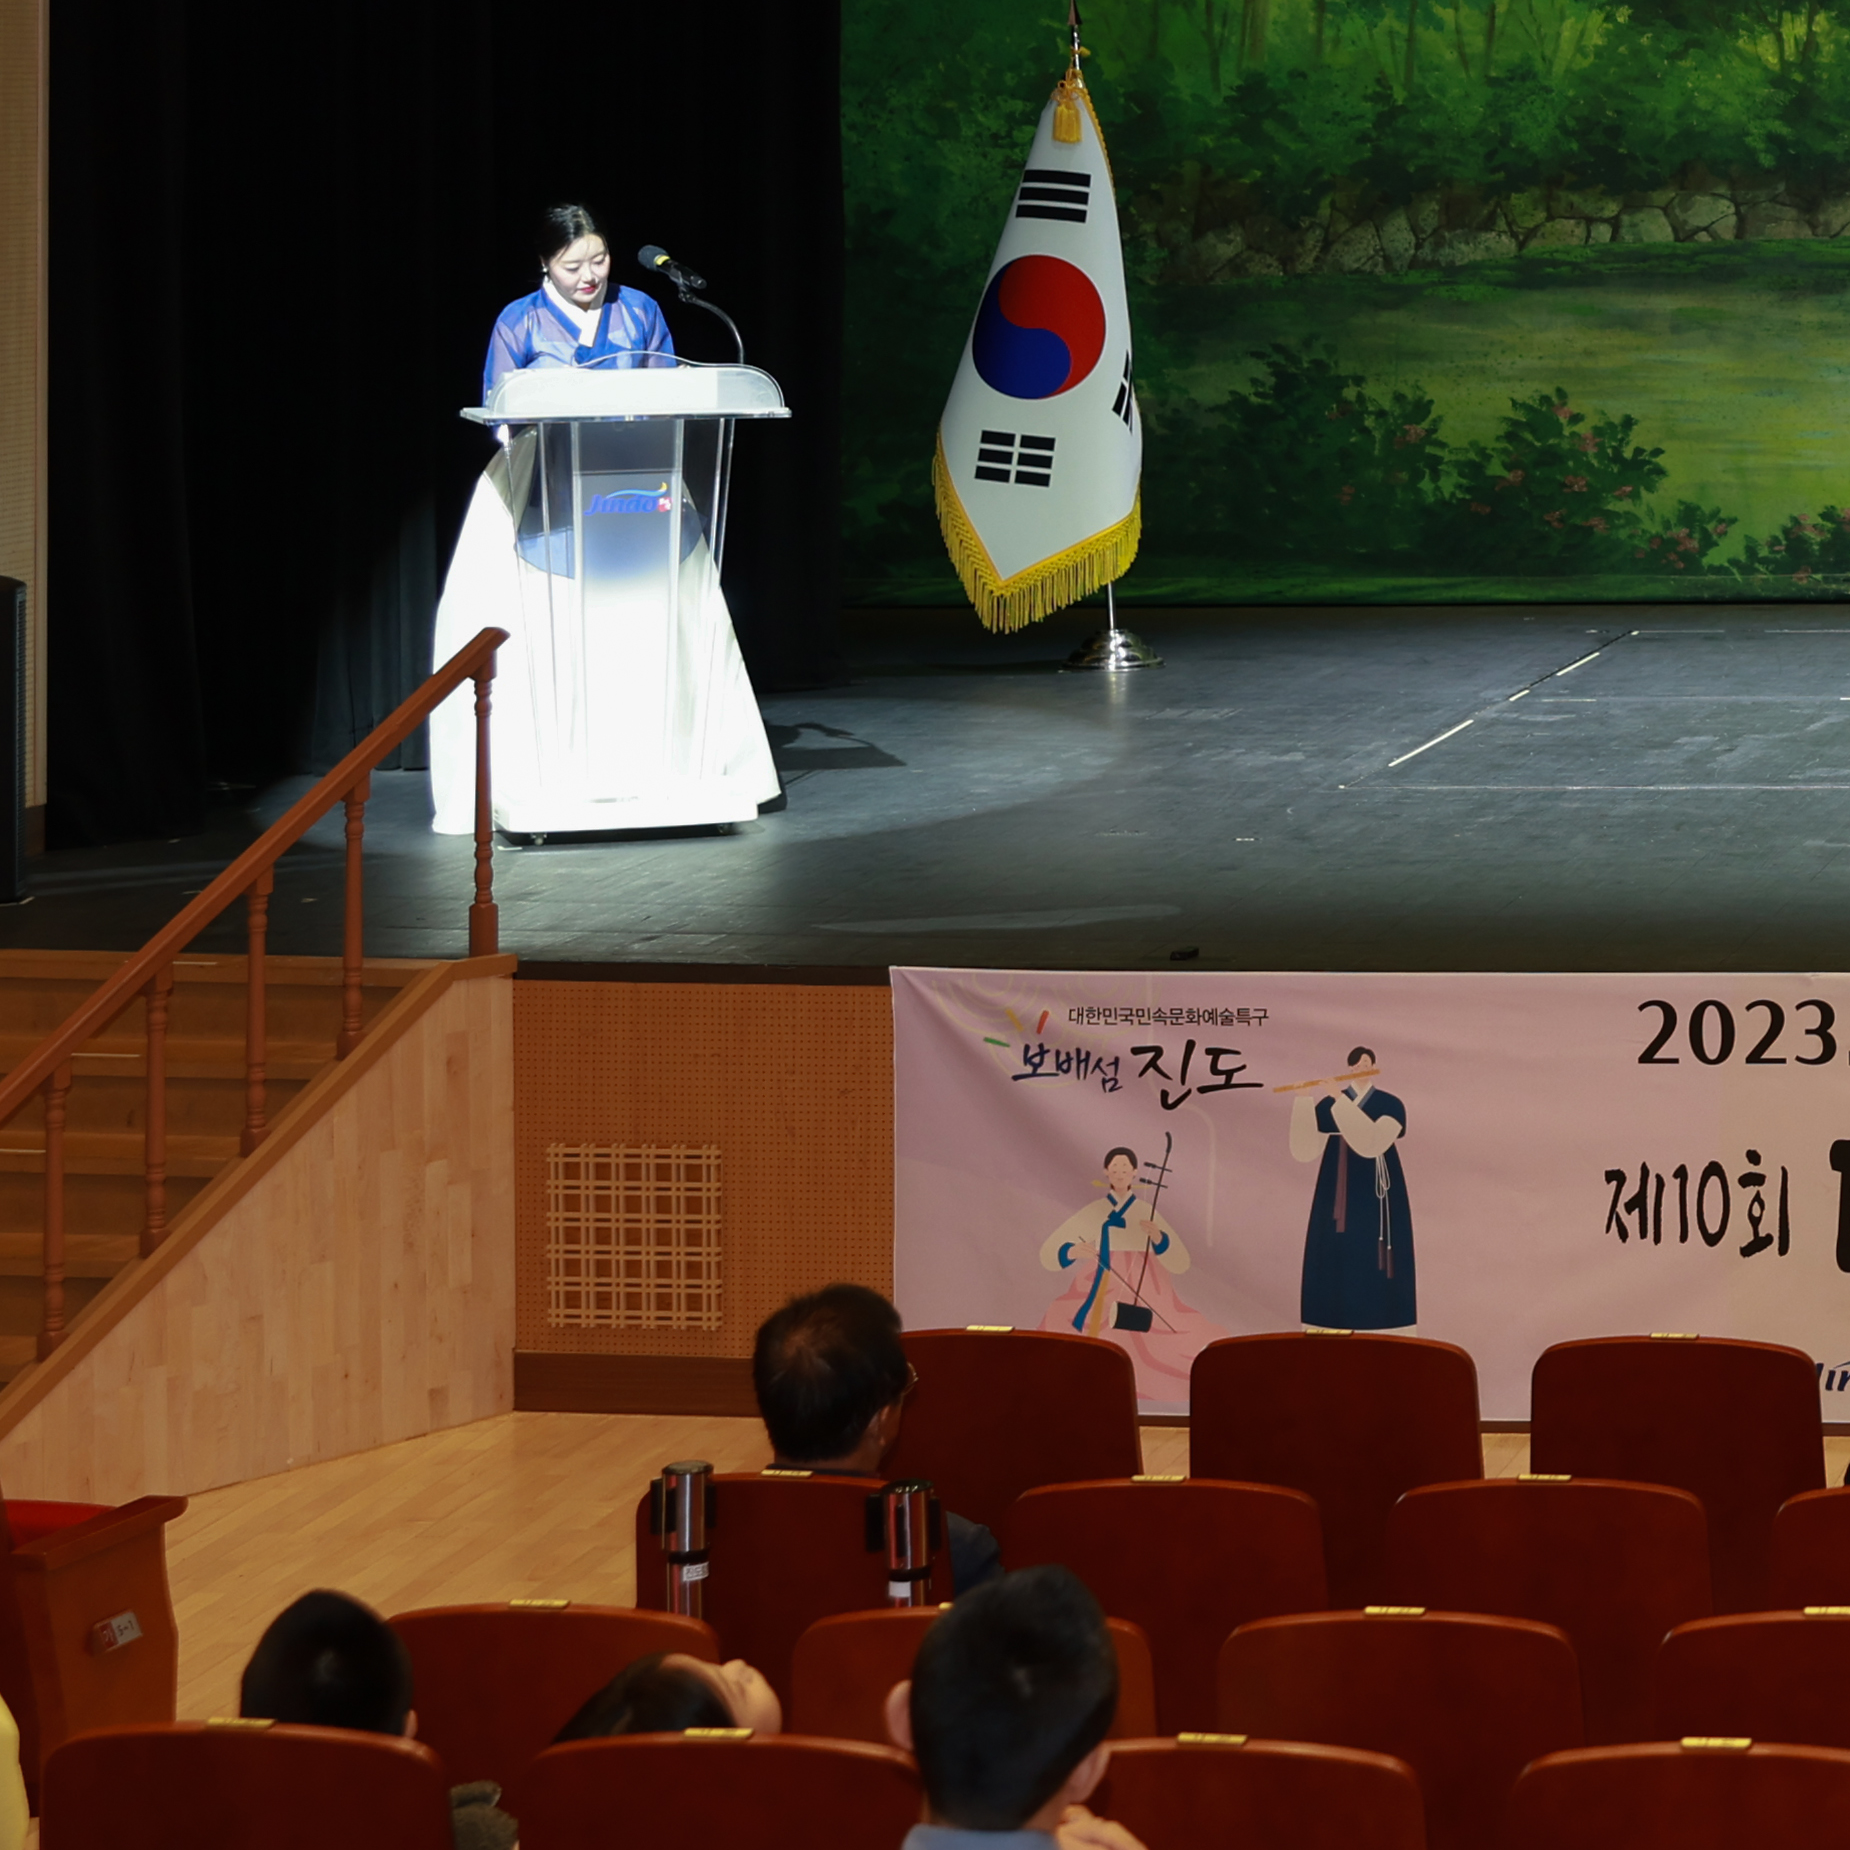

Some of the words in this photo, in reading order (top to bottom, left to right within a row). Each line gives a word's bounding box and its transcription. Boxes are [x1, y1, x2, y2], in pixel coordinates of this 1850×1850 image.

[1069, 1006, 1269, 1026] 대한민국민속문화예술특구
[1011, 1043, 1122, 1093] 보배섬
[1130, 1039, 1264, 1111] 진도
[1604, 1150, 1791, 1258] 제10회
